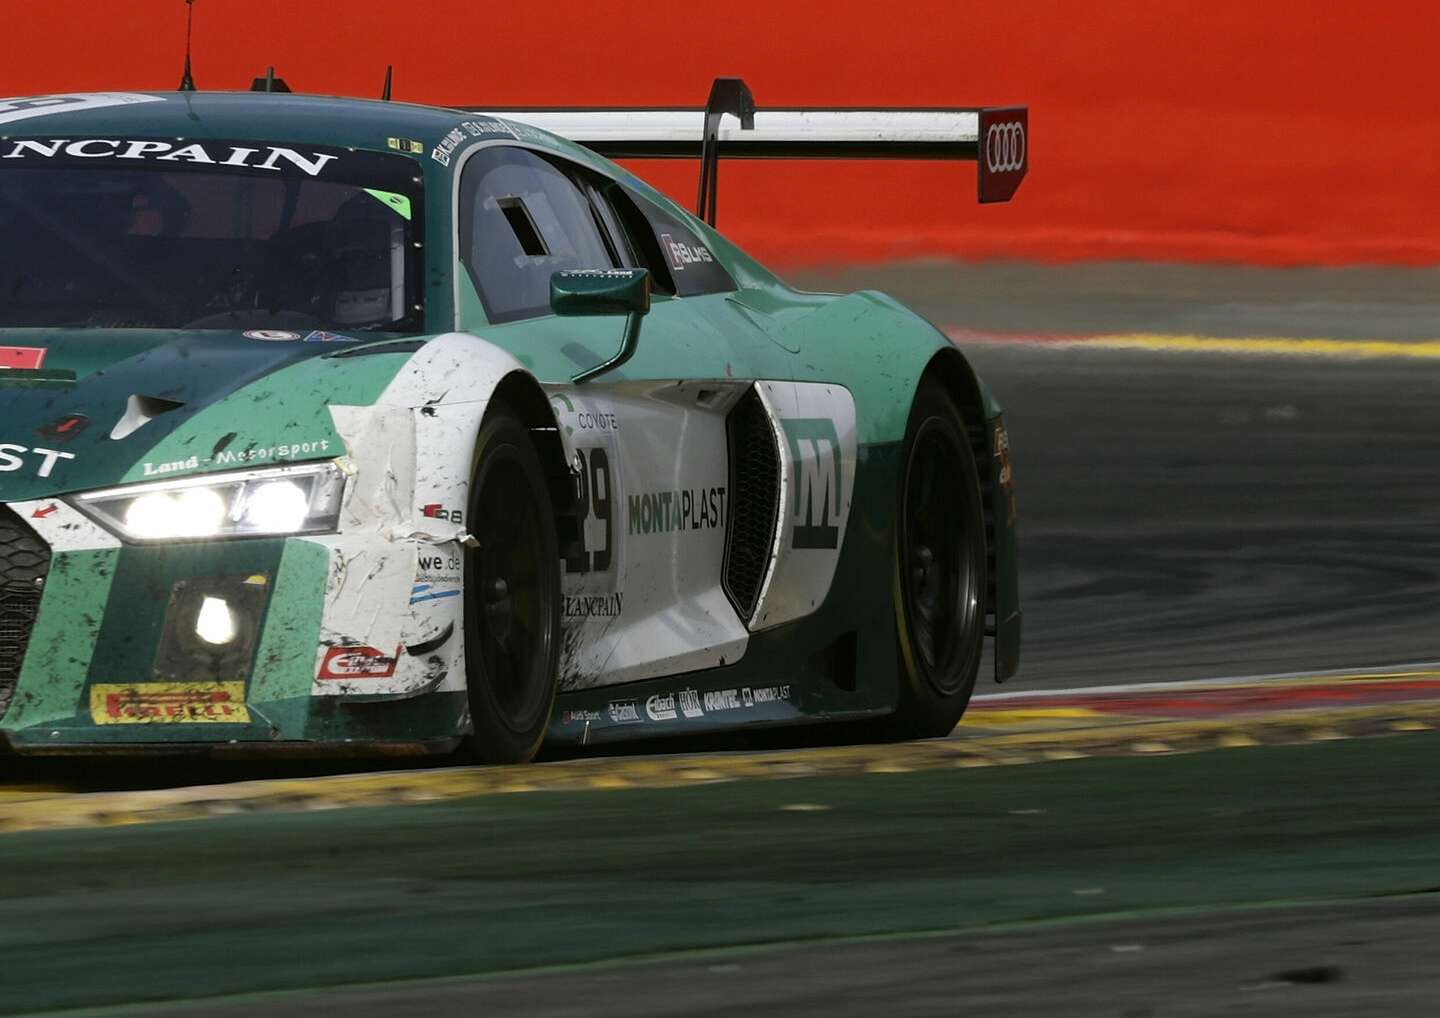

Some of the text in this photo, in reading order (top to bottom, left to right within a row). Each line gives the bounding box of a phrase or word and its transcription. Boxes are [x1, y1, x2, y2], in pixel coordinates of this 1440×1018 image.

[578, 413, 618, 430] COYOTE
[143, 456, 199, 476] Land
[628, 487, 726, 535] MONTAPLAST
